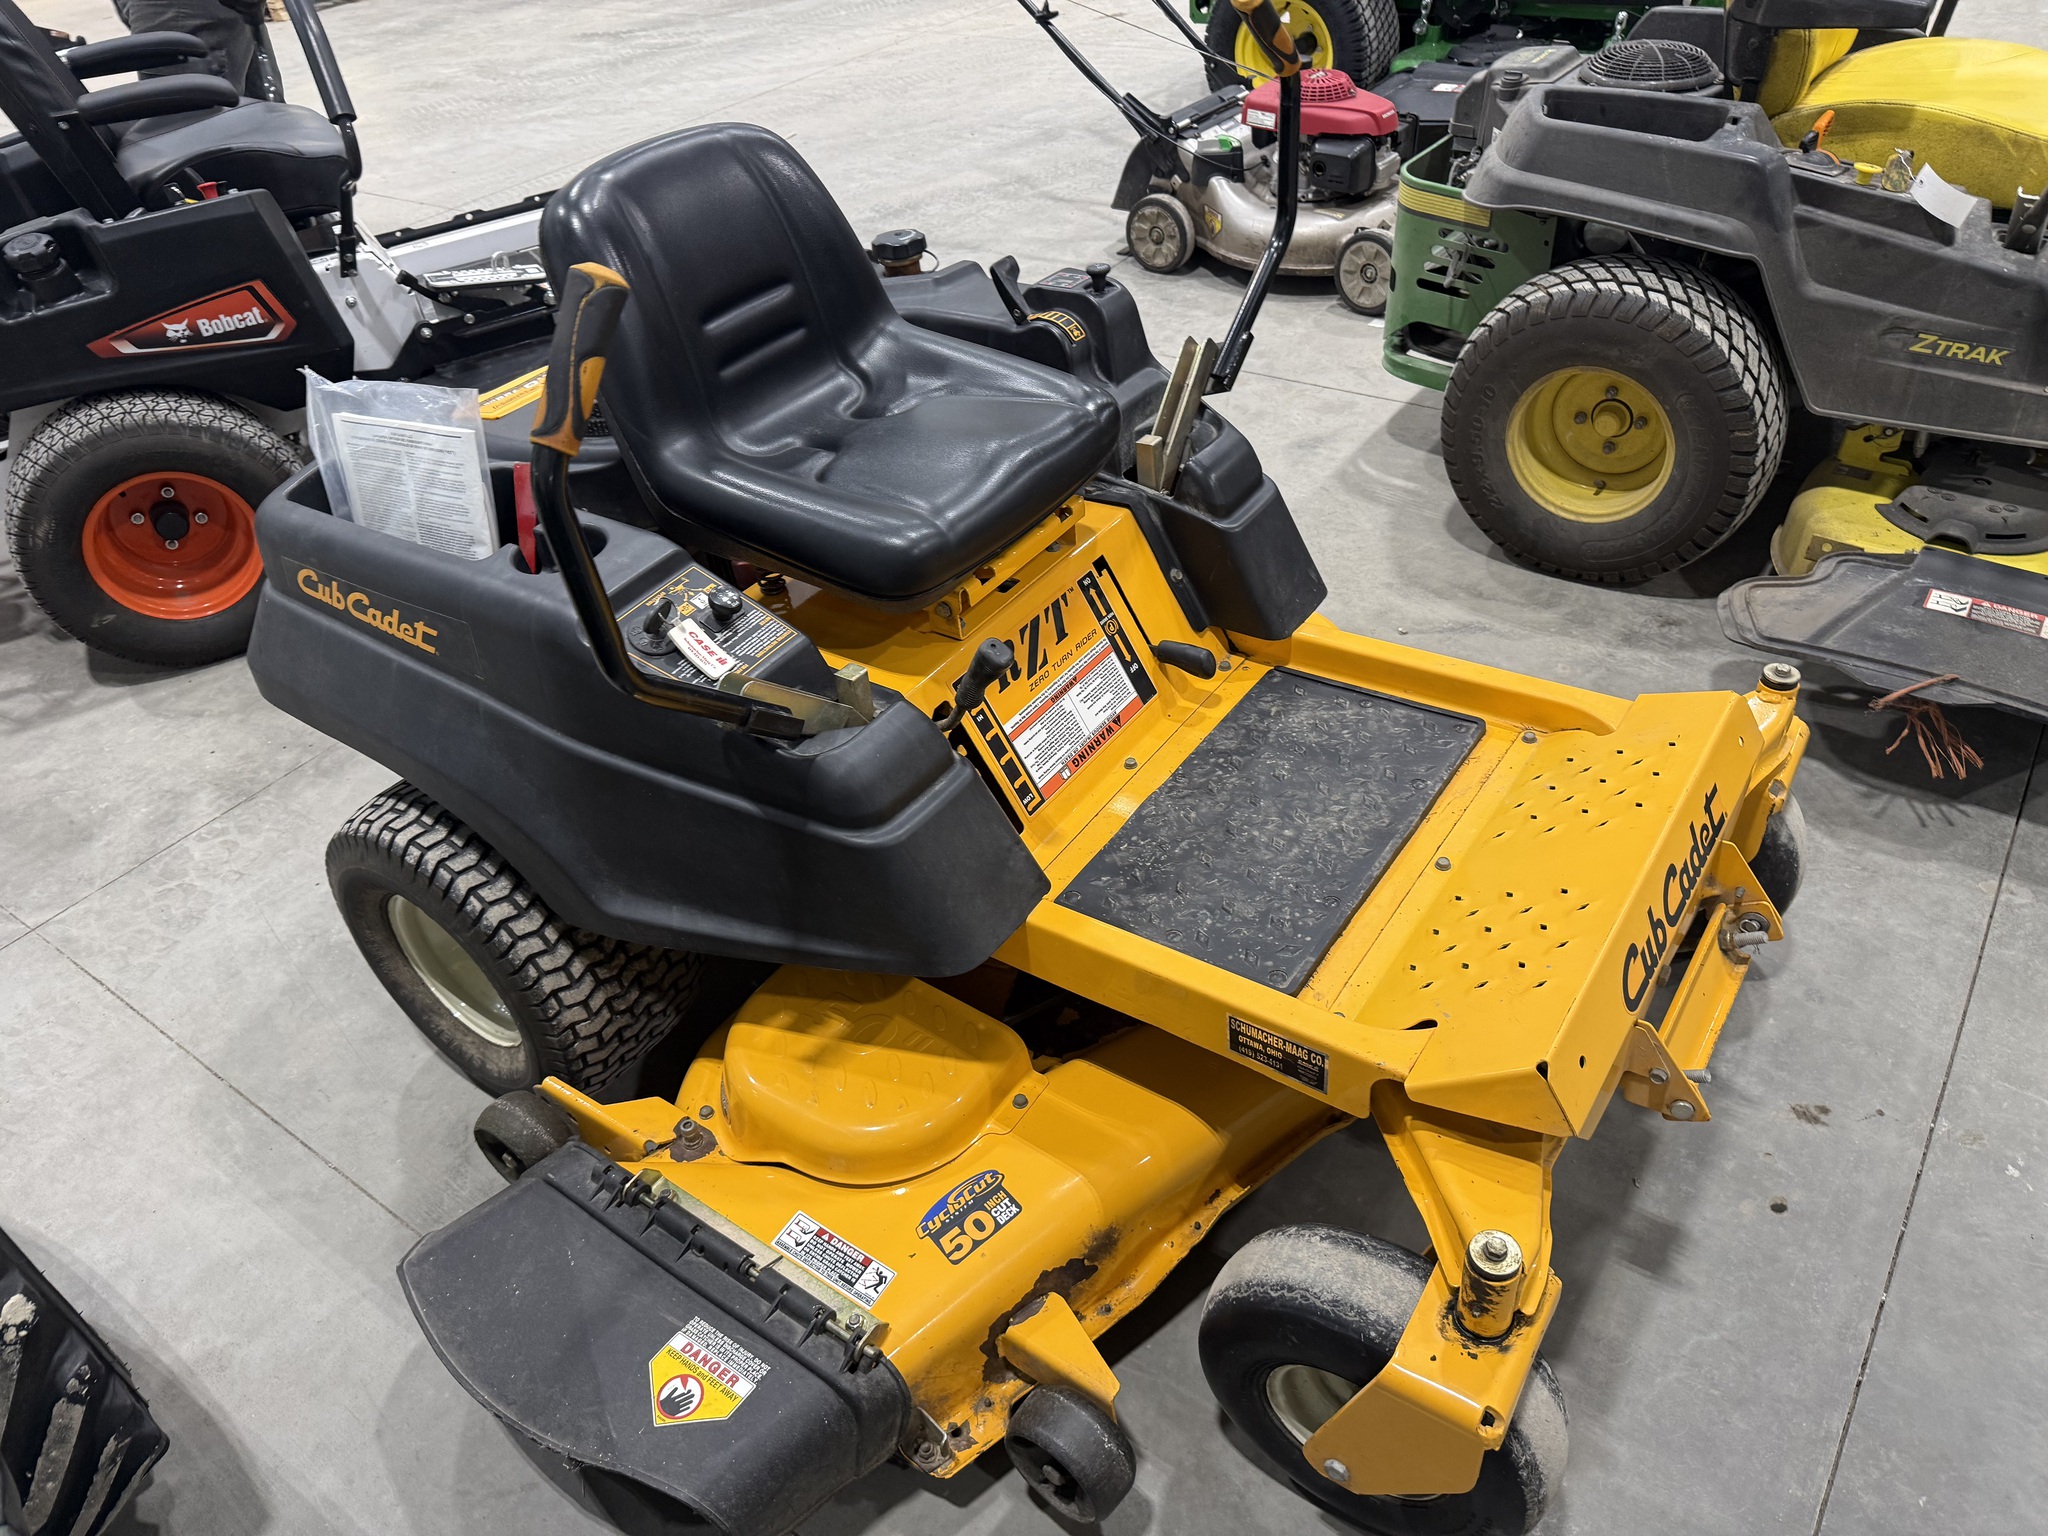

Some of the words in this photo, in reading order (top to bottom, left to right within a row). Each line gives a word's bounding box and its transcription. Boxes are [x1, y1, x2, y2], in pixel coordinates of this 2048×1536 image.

[196, 306, 265, 337] Bobcat
[1909, 333, 2011, 366] ZTRAK
[1083, 577, 1091, 586] ON
[297, 568, 345, 611] Cub
[347, 592, 438, 654] Cadet
[1993, 603, 2038, 619] DANGER
[689, 632, 717, 657] CASE
[1029, 672, 1050, 692] ZERO
[1052, 650, 1073, 672] TURN
[1075, 628, 1097, 651] RIDER
[1130, 662, 1139, 673] OFF
[1049, 678, 1074, 703] WARNING
[976, 714, 984, 722] HI
[1071, 725, 1115, 767] WARNING
[1022, 793, 1034, 805] LOW
[1622, 905, 1668, 1012] Cub
[1663, 783, 1726, 927] Cadet
[1231, 1019, 1308, 1060] SCHUMACHER-MAAG
[1310, 1054, 1324, 1067] CO.
[1238, 1035, 1265, 1052] OTTAWA,
[1266, 1048, 1283, 1059] OHIO
[984, 1191, 1007, 1211] INCH
[991, 1198, 1011, 1217] CUT
[996, 1204, 1020, 1225] DECK
[939, 1210, 995, 1261] 50
[829, 1237, 865, 1263] DANGER
[666, 1348, 682, 1361] KEEP
[680, 1358, 698, 1374] HANDS
[697, 1371, 708, 1380] and
[706, 1377, 722, 1389] FEET
[720, 1386, 739, 1402] AWAY
[680, 1342, 740, 1388] DANGER
